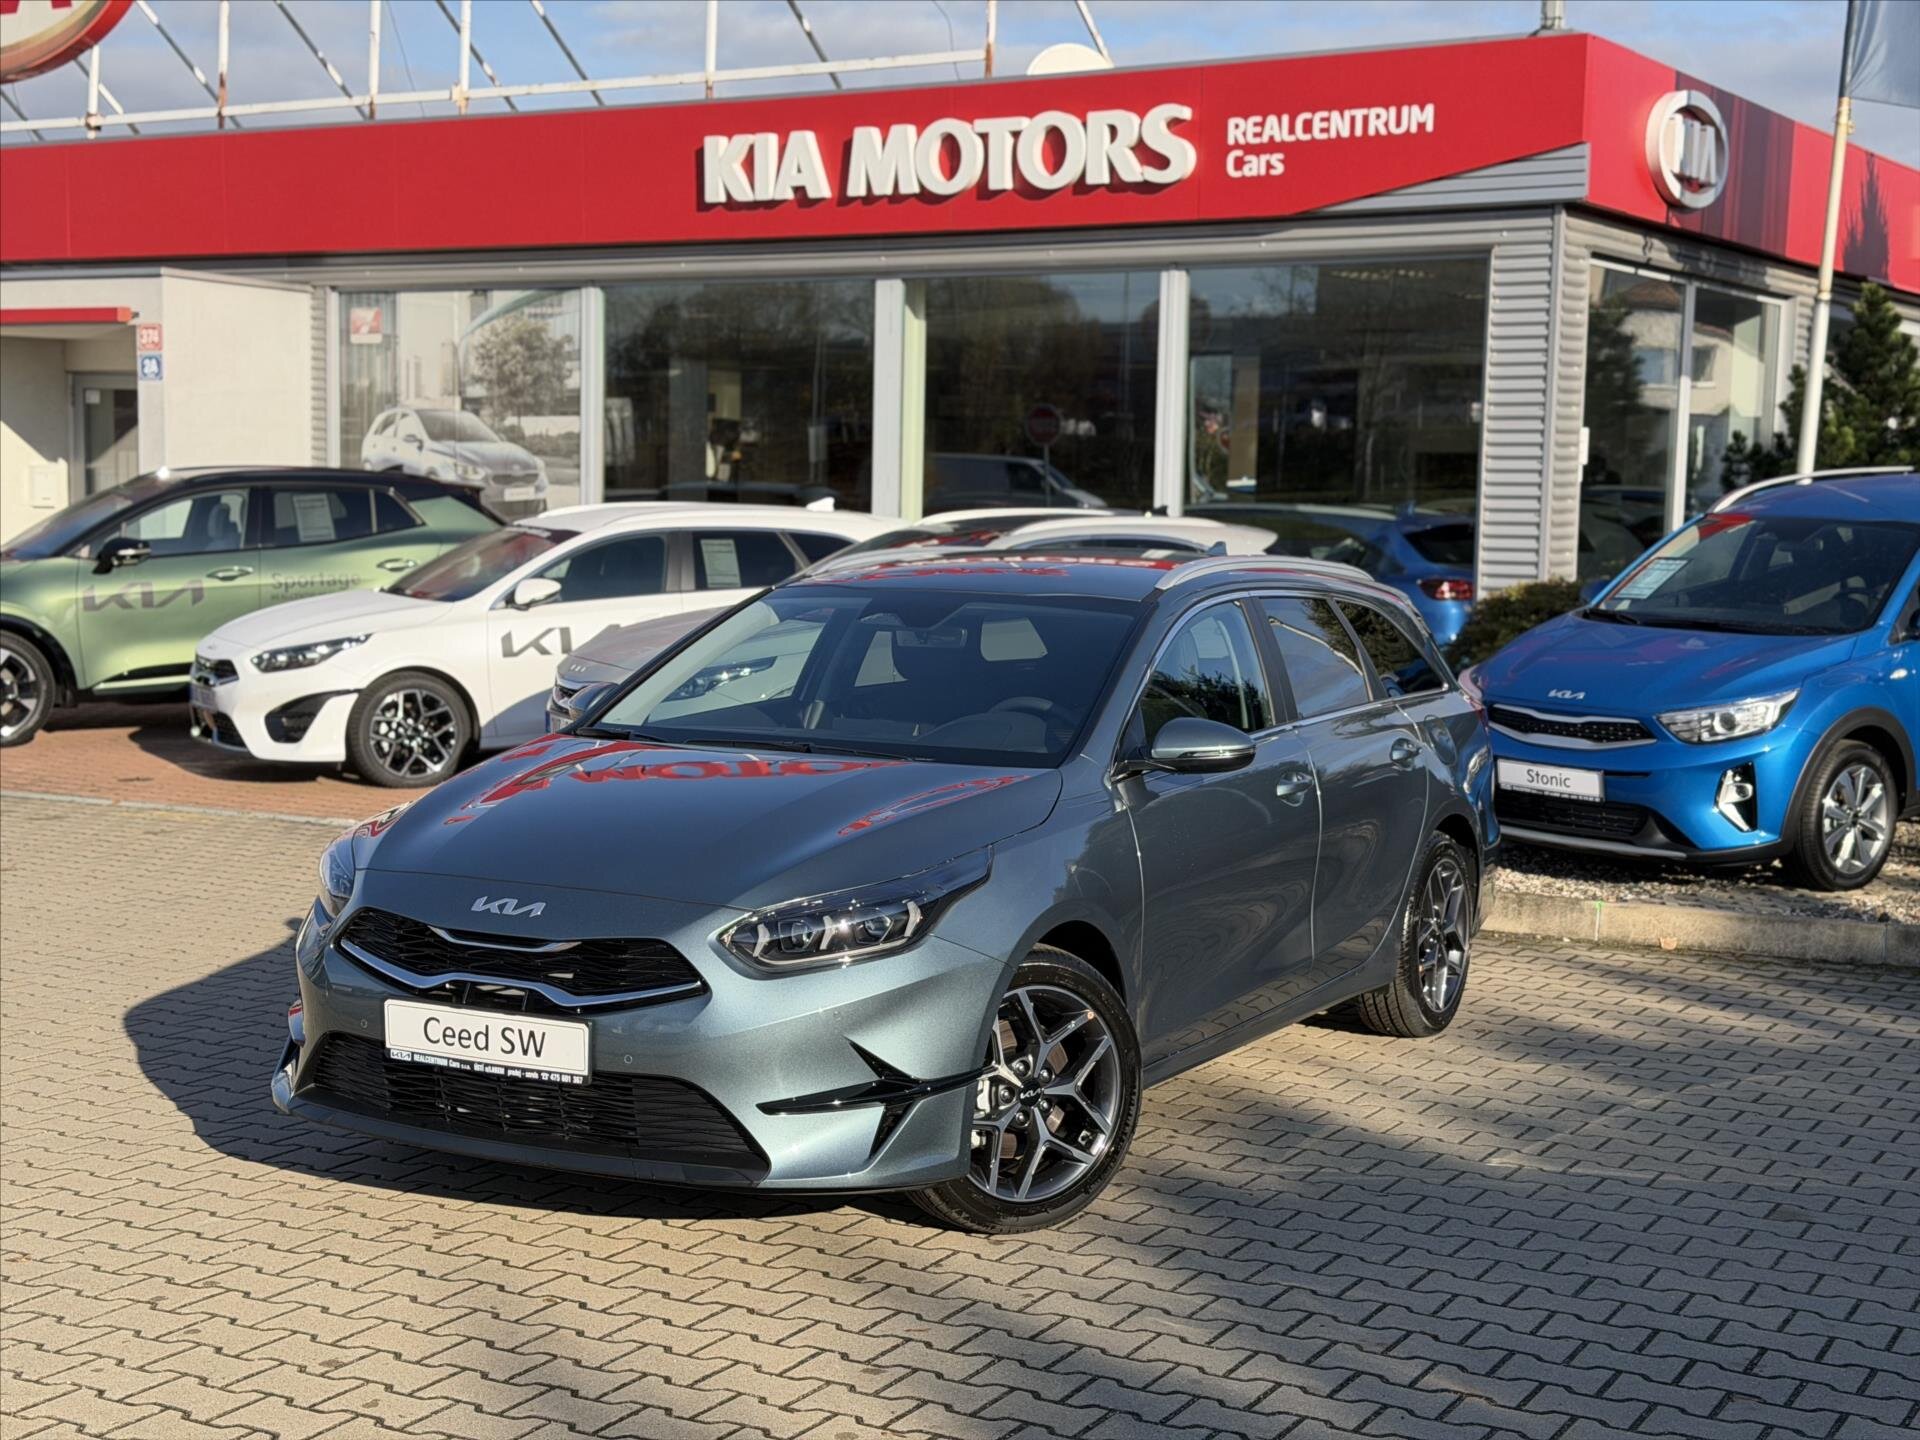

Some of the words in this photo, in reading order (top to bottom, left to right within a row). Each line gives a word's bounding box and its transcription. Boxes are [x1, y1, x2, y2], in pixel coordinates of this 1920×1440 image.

[1226, 103, 1435, 146] REALCENTRUM
[703, 130, 832, 203] KIA
[846, 103, 1197, 197] MOTORS
[1226, 149, 1285, 178] Cars
[82, 579, 205, 611] KIA
[272, 572, 360, 593] Sportage
[1548, 689, 1586, 700] KIA
[1526, 768, 1571, 788] Stonic
[471, 896, 546, 917] KIA
[423, 1016, 489, 1052] Ceed
[500, 1026, 546, 1058] SW
